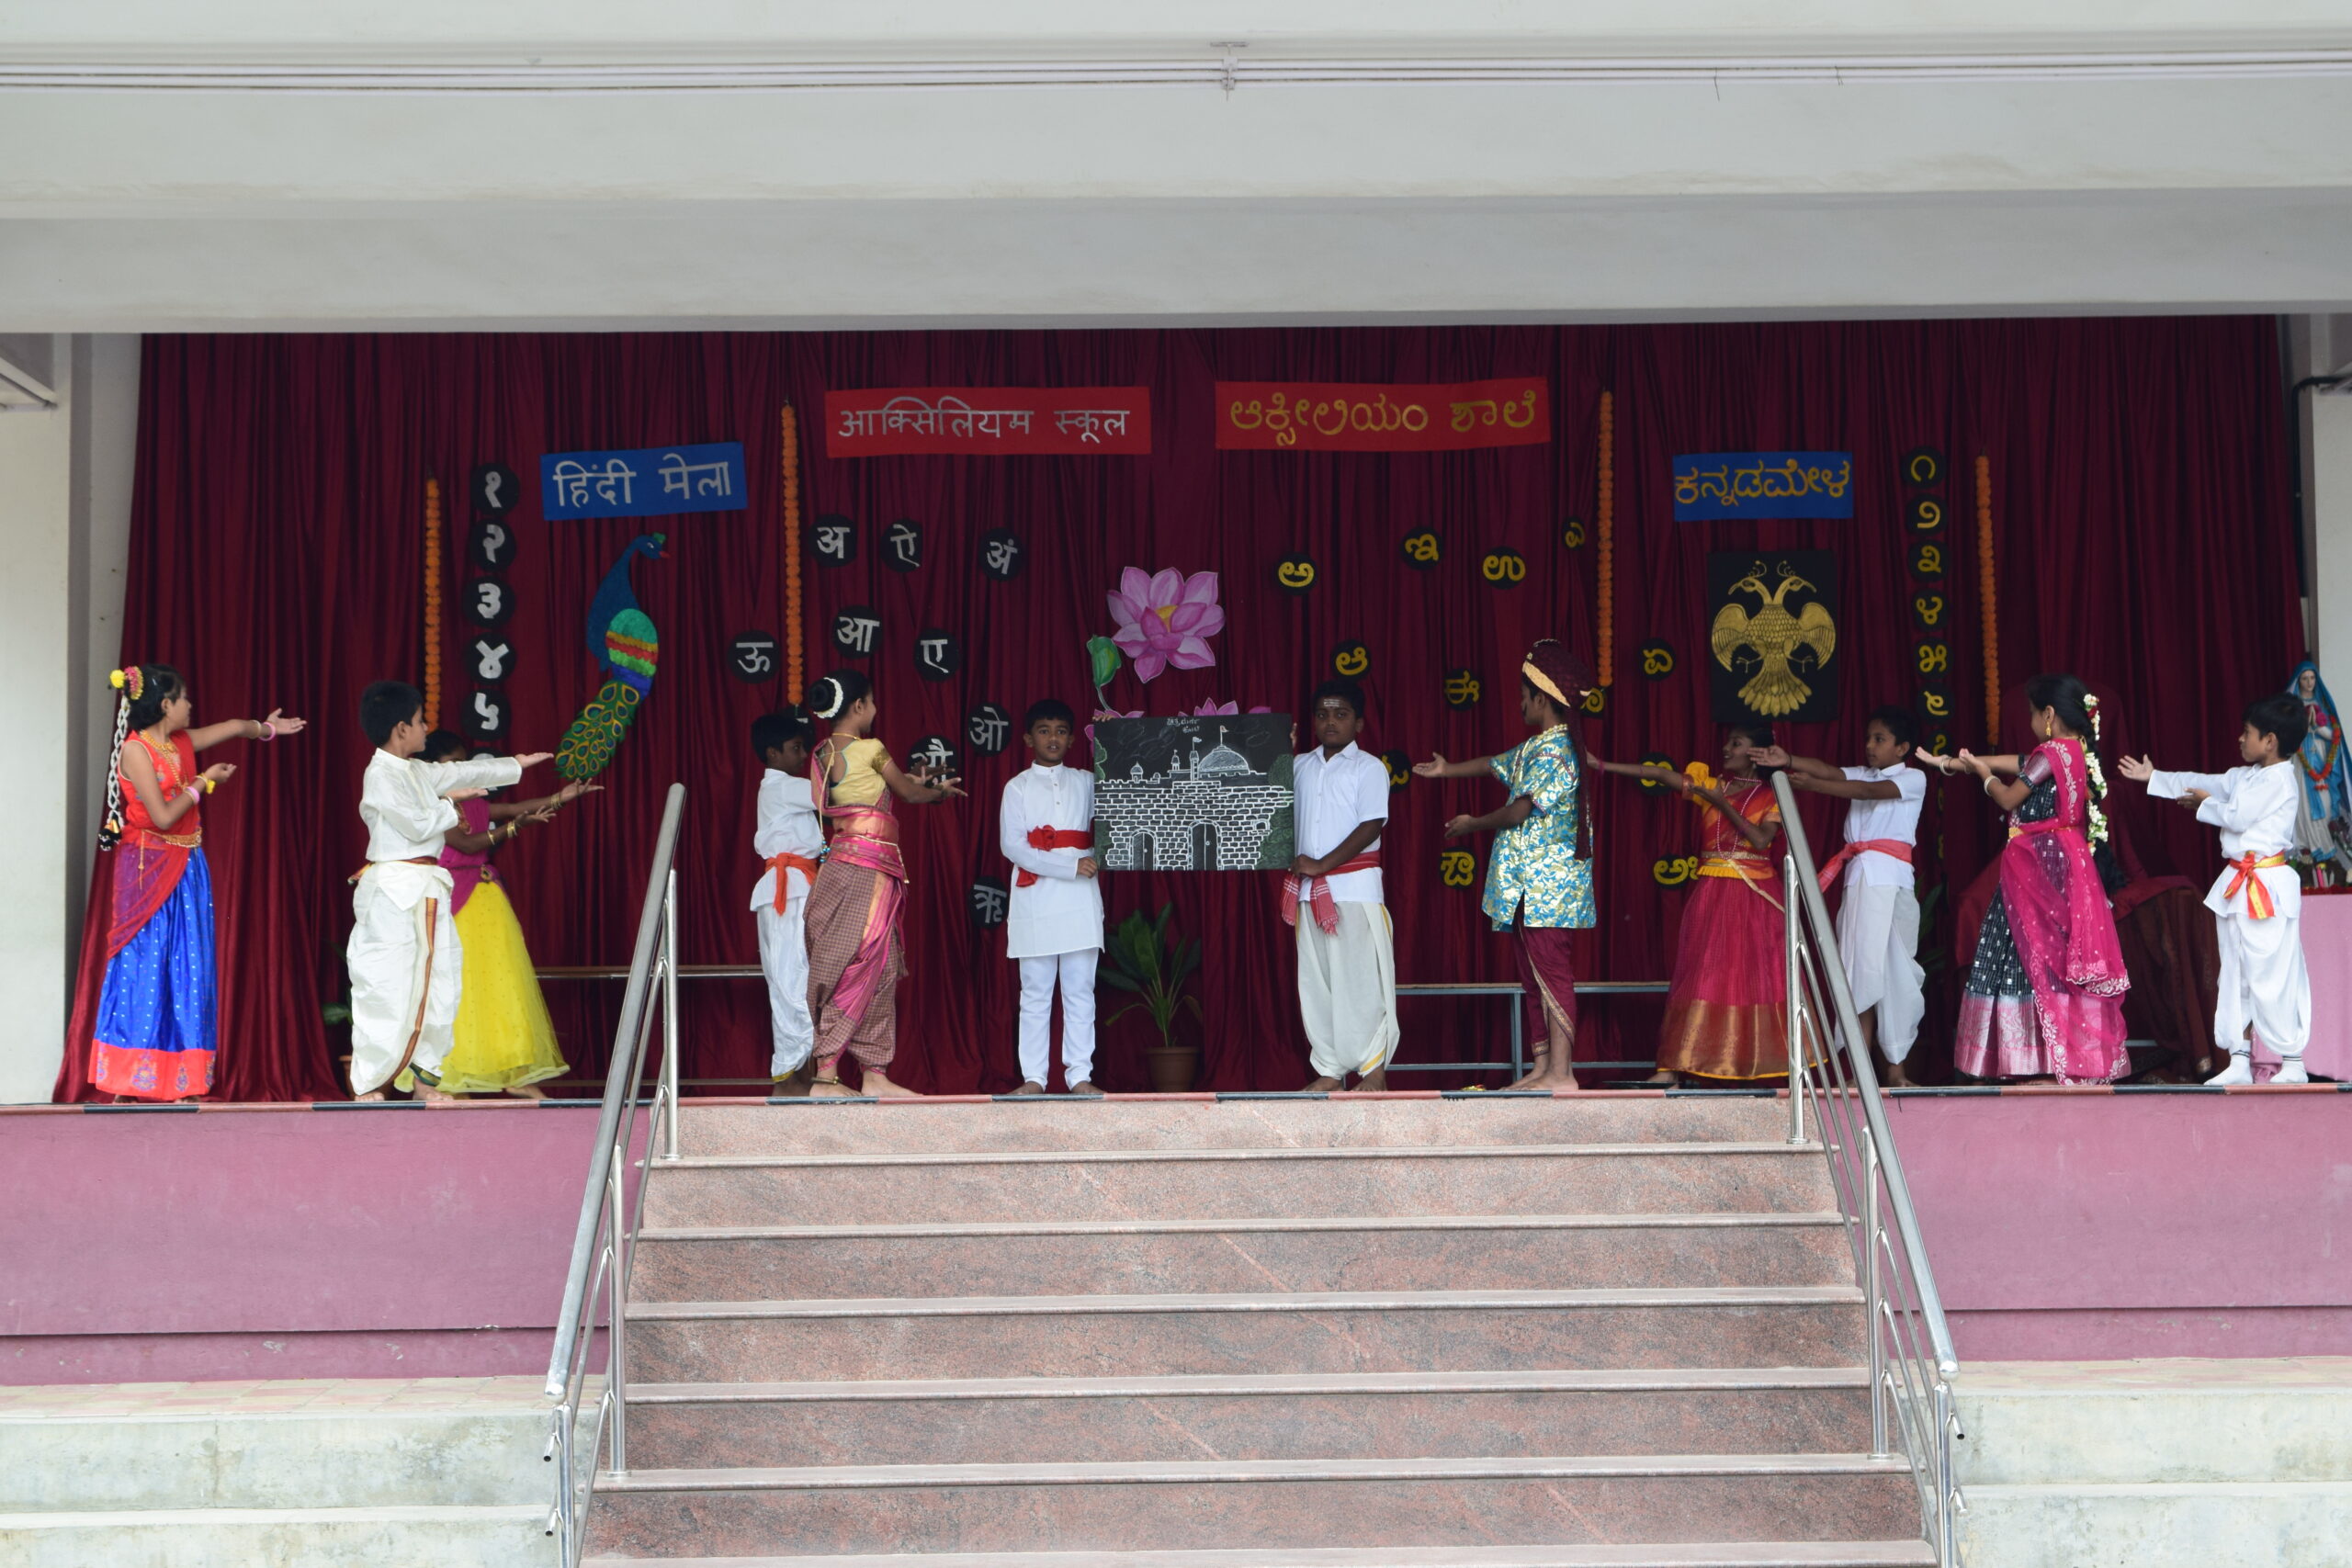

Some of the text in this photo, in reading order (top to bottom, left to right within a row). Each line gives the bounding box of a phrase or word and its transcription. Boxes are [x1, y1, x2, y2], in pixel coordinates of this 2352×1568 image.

[839, 396, 1130, 444] आक्सिलियम स्कूल
[1450, 389, 1537, 432] ಶಾಲೆ
[552, 453, 731, 508] हिंदी मेला
[1675, 458, 1850, 507] ಕನ್ನಡಮೇಳ
[482, 524, 505, 563] २
[817, 526, 851, 559] अ
[890, 524, 921, 568] ऐ
[987, 538, 1018, 575] अं
[1278, 561, 1315, 588] ಅ
[1482, 555, 1526, 581] ಉ
[837, 616, 880, 653] आ
[736, 642, 774, 673] ऊ
[920, 638, 949, 673] ए
[969, 706, 1009, 751] ओ
[974, 884, 1007, 924] ऋ
